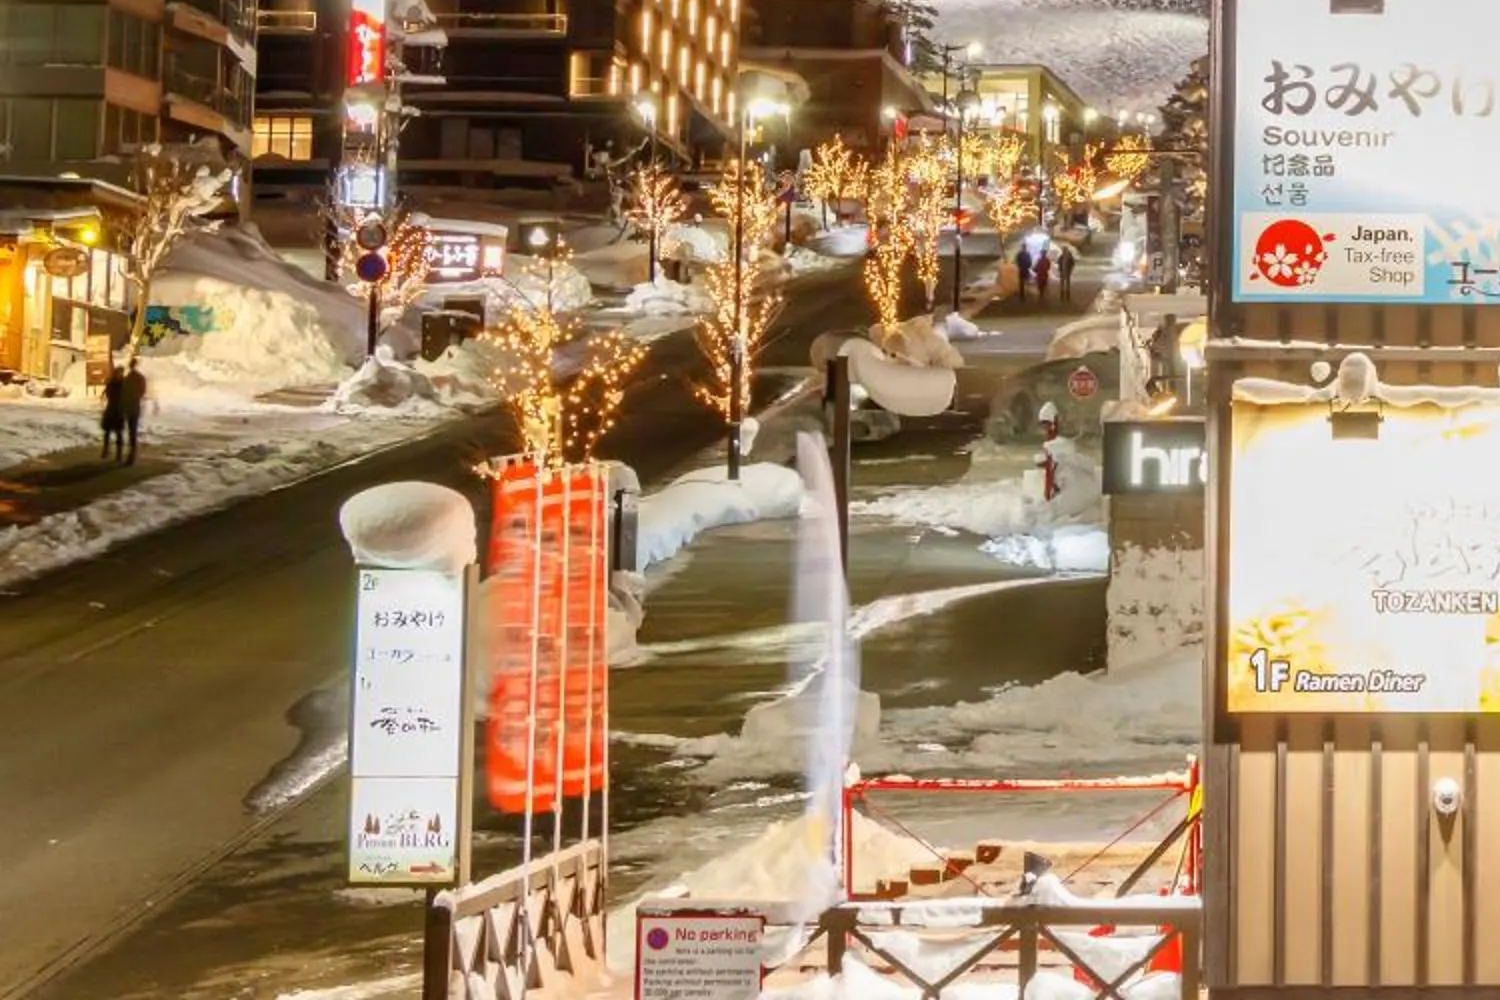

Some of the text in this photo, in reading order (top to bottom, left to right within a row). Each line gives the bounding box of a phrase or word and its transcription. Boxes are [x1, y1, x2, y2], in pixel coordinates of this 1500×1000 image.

[1263, 125, 1394, 147] Souvenir
[1344, 247, 1415, 264] Tax-free
[1369, 266, 1415, 288] Shop
[1372, 589, 1498, 614] TOZANKEN
[1250, 648, 1425, 692] 1F Ramen Diner
[676, 927, 757, 943] No parking
